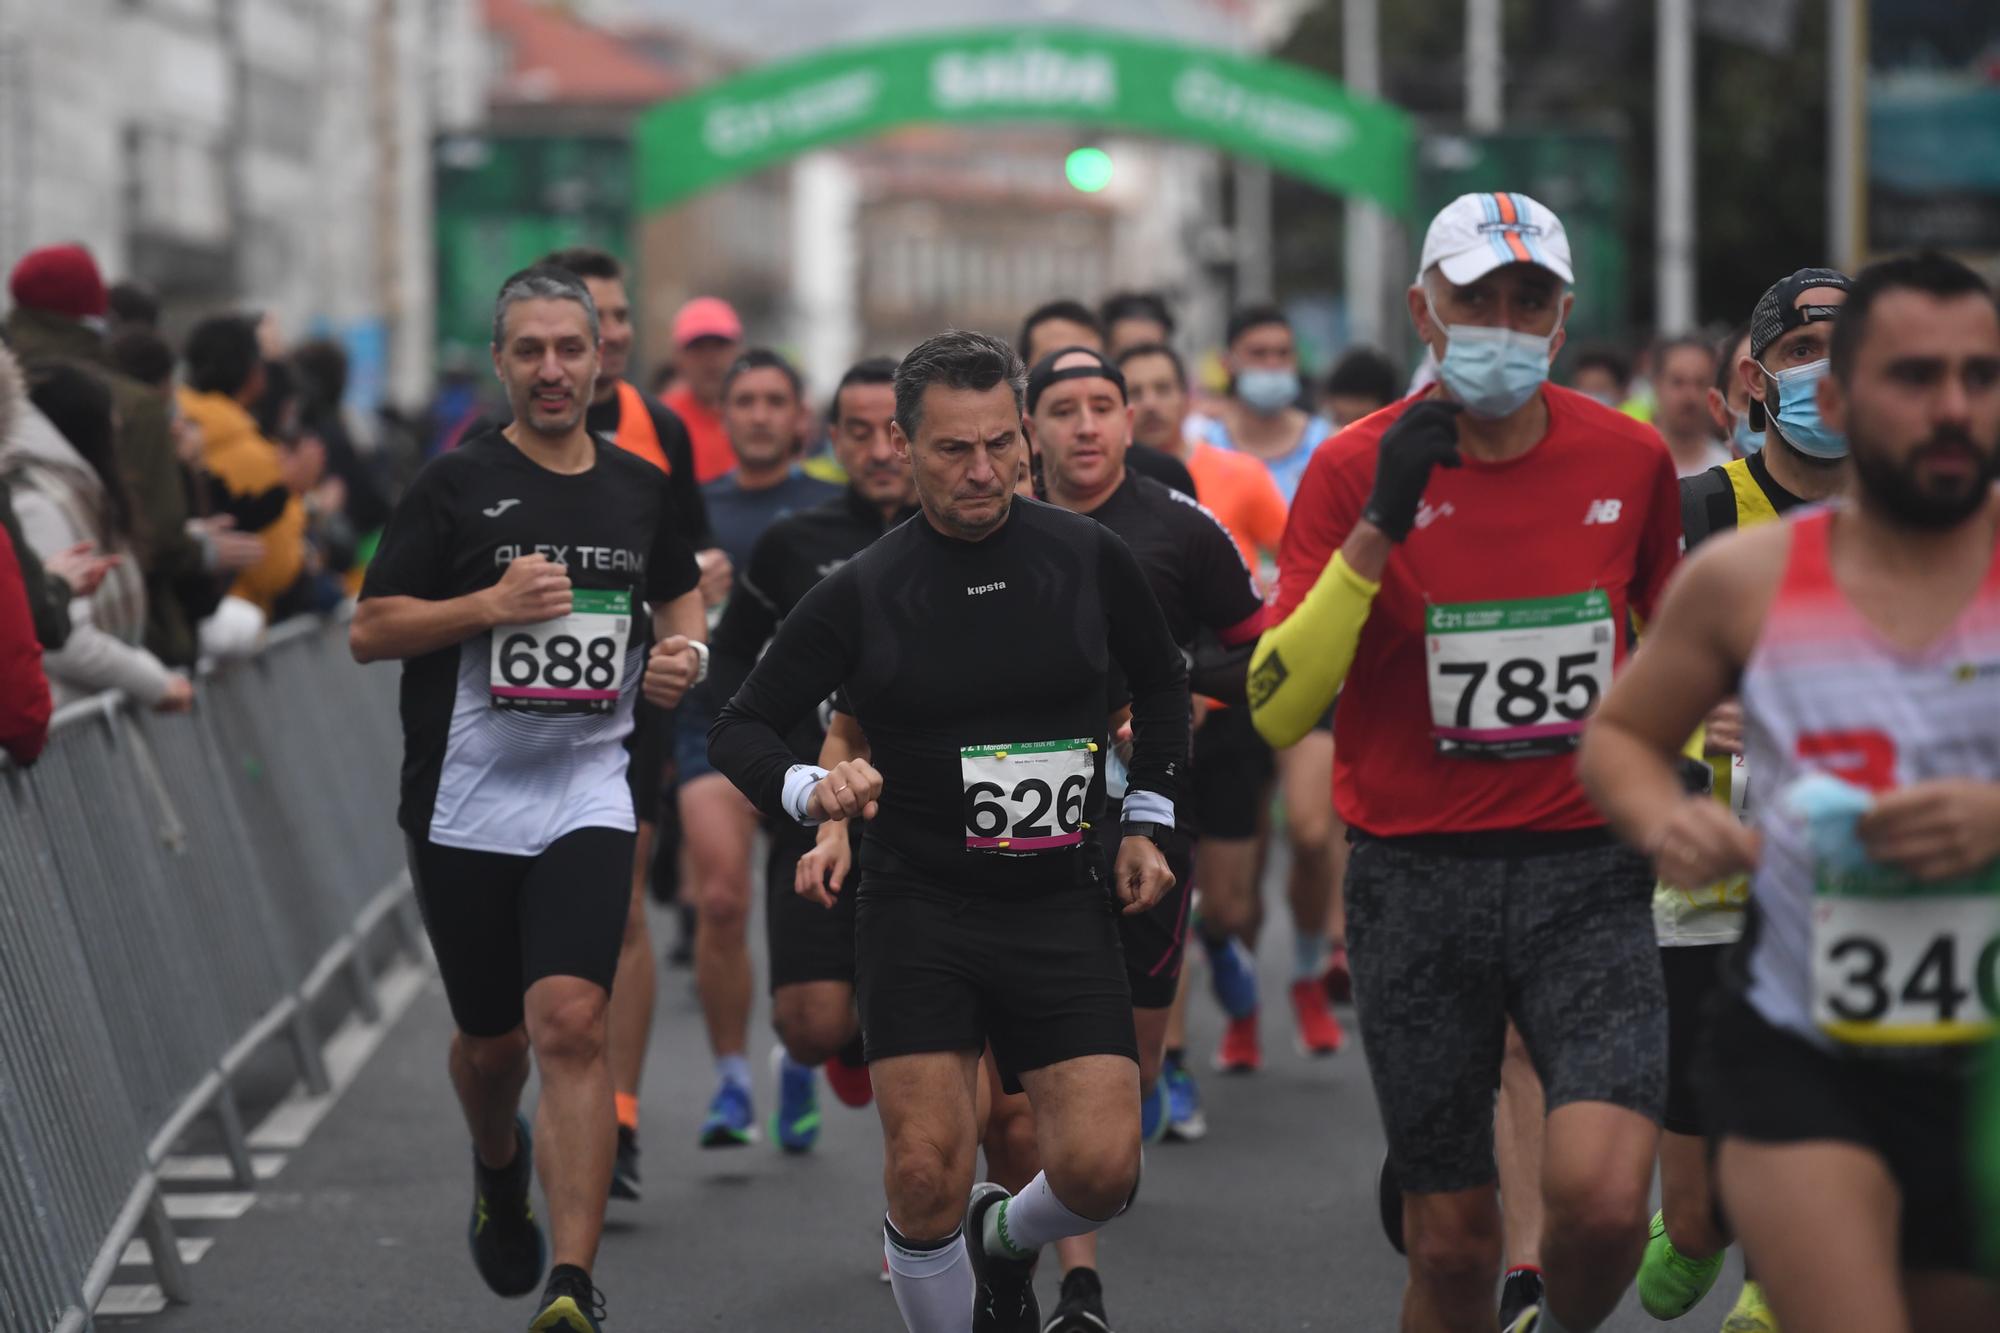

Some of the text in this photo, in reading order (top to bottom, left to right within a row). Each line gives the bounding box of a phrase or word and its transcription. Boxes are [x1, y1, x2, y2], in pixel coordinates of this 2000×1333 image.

[1583, 499, 1622, 525] NB
[576, 546, 644, 572] TEAM
[967, 581, 1006, 595] kipsta
[500, 633, 616, 689] 688
[1439, 651, 1600, 728] 785
[963, 774, 1087, 838] 626
